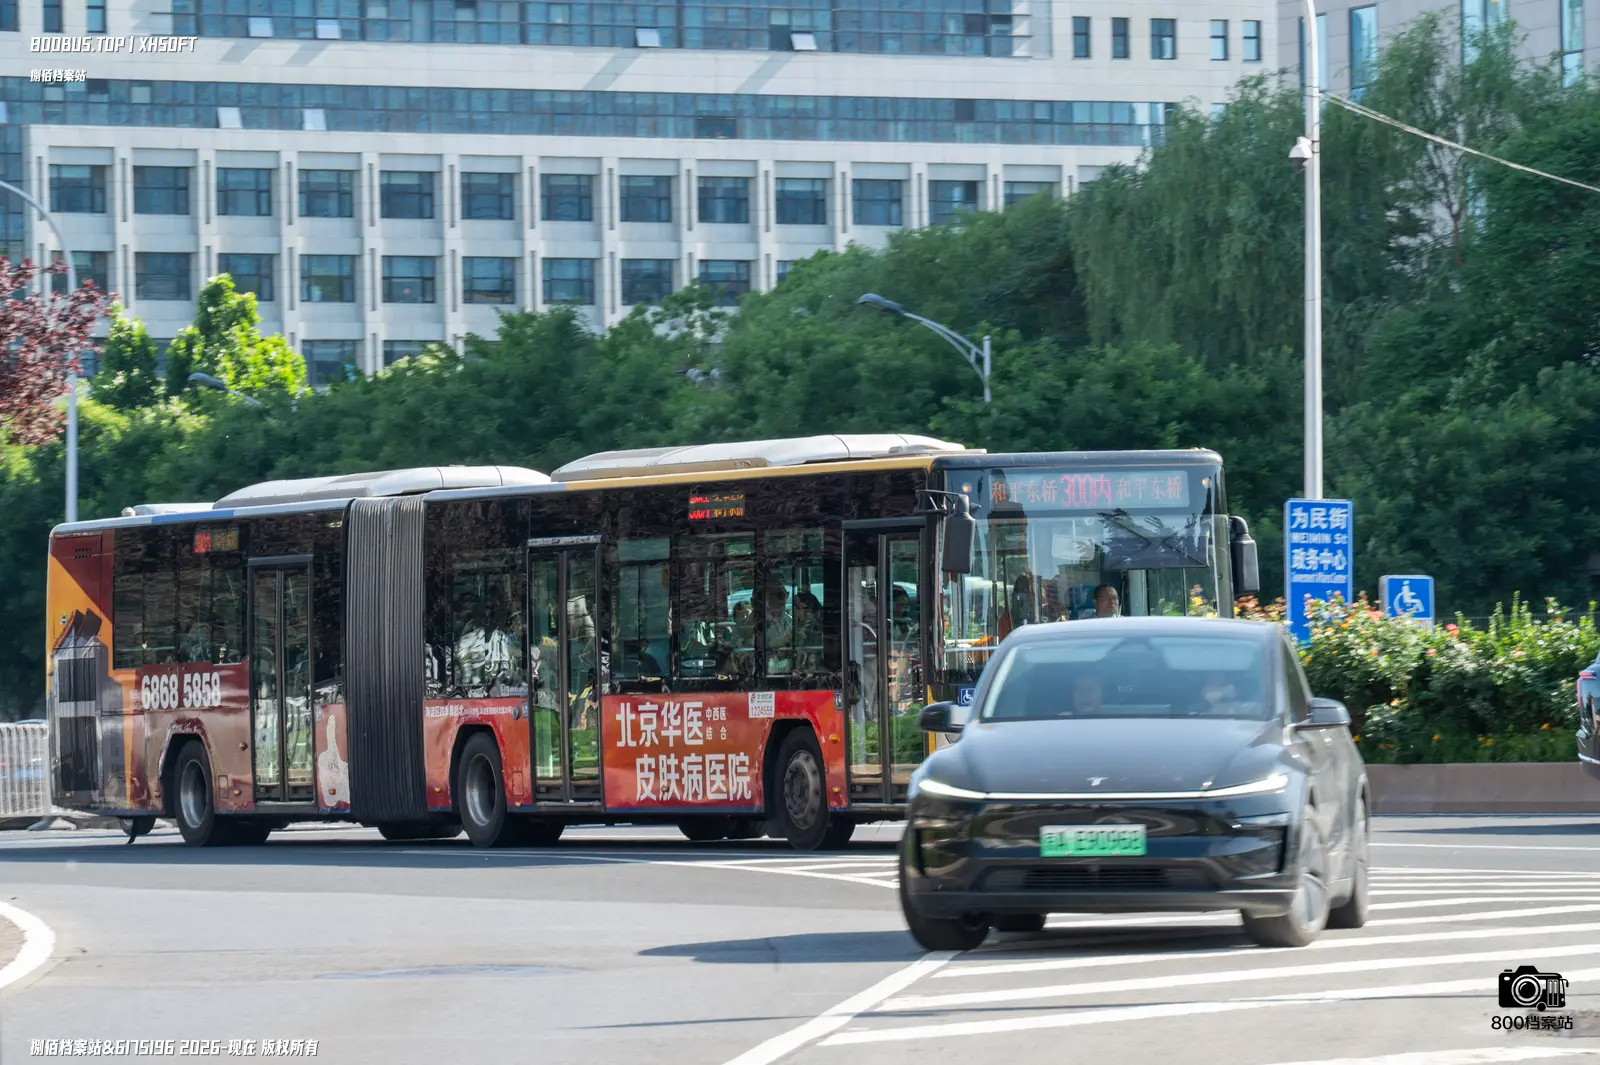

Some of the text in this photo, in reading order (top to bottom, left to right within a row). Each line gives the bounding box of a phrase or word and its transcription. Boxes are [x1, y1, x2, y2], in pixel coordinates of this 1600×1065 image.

[1060, 474, 1112, 507] 300内
[1292, 506, 1348, 530] 为民街
[142, 674, 179, 710] 6868
[183, 671, 221, 708] 5858
[615, 701, 704, 748] 北京华医
[705, 706, 727, 721] 中西医
[635, 752, 752, 802] 皮肤病医院
